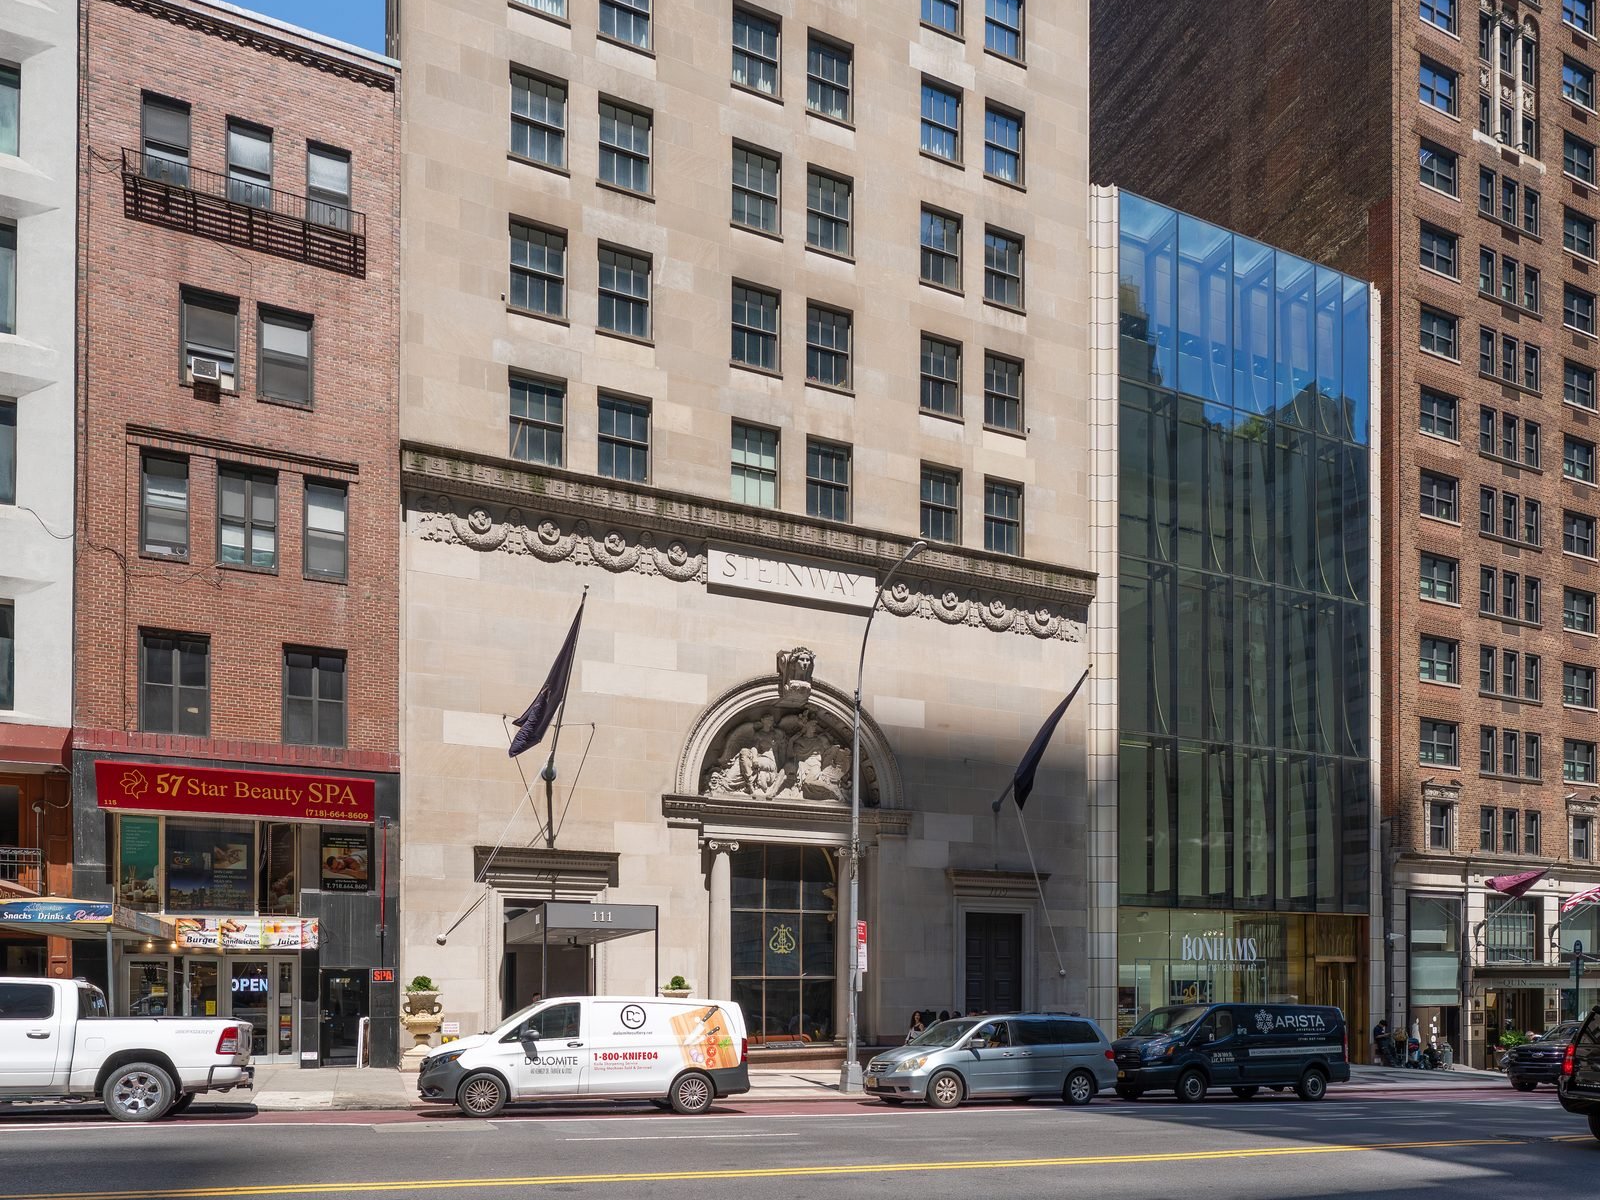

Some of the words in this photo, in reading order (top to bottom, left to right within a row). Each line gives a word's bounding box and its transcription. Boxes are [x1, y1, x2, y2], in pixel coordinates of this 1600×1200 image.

[722, 553, 861, 597] STEINWAY
[156, 773, 185, 797] 57
[187, 779, 229, 797] Star
[234, 781, 304, 806] Beauty
[308, 782, 359, 806] SPA
[305, 808, 369, 820] (718)-664-8609
[3, 911, 32, 920] Snacks
[38, 911, 64, 921] Drinks
[592, 911, 613, 922] 111
[186, 936, 217, 945] Burger
[221, 937, 260, 946] Sandwiches
[277, 937, 299, 947] Juice
[1182, 936, 1257, 961] BONHAMS
[373, 970, 393, 982] SPA
[231, 978, 269, 992] OPEN
[1503, 979, 1527, 988] QUIN
[626, 1010, 641, 1023] DC
[1275, 1015, 1326, 1028] ARISTA
[524, 1056, 578, 1066] DOLOMITE
[593, 1052, 659, 1061] 1-800-KNIFE04
